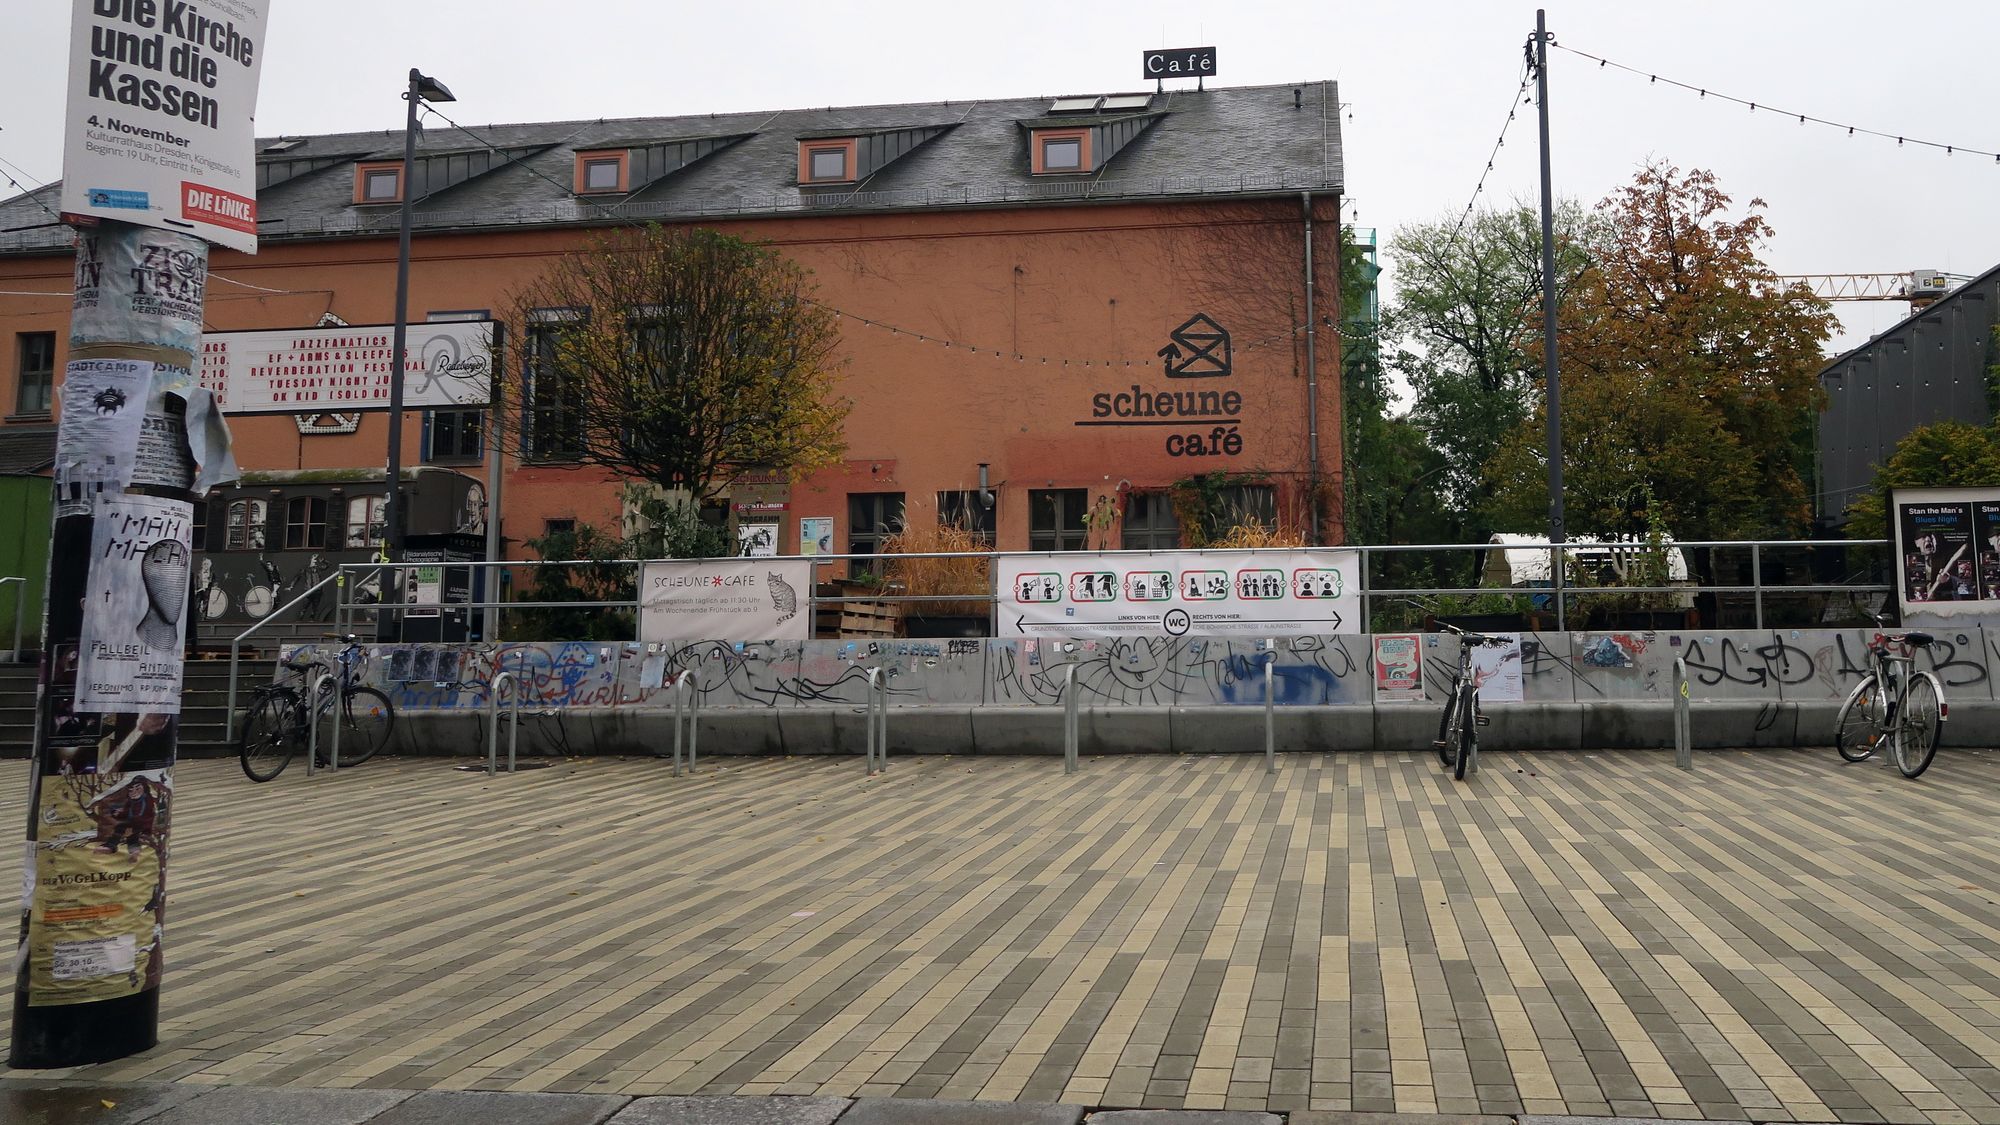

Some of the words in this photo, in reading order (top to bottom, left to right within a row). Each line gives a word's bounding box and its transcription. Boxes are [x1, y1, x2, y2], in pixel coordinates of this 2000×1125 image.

[94, 0, 155, 29] Die
[162, 0, 253, 67] Kirche
[91, 26, 163, 72] und
[170, 43, 217, 89] die
[1147, 53, 1211, 73] Café
[89, 59, 218, 129] Kassen
[87, 114, 104, 129] 4.
[108, 118, 190, 148] November
[86, 129, 153, 151] Kulturrathaus
[154, 143, 193, 162] Dresden,
[86, 141, 124, 157] Beginn:
[126, 149, 138, 160] 19
[139, 152, 158, 166] Uhr,
[160, 156, 188, 173] Eintritt
[187, 189, 214, 212] DIE
[293, 336, 388, 350] JAZZFANATICS
[269, 353, 282, 363] EF
[300, 352, 330, 362] ARMS
[345, 349, 408, 360] SLEEPES
[251, 363, 354, 377] REVERBERATION
[365, 361, 426, 373] FESTVAL
[270, 378, 323, 389] TUESDAY
[330, 376, 368, 387] NIGHT
[273, 392, 287, 402] OK
[296, 391, 318, 401] KID
[1093, 385, 1242, 418] scheune
[1166, 426, 1243, 457] café
[1908, 507, 1926, 515] Stan
[654, 576, 710, 588] SCHEUNE
[724, 575, 755, 587] CAFE
[1168, 618, 1186, 627] WC
